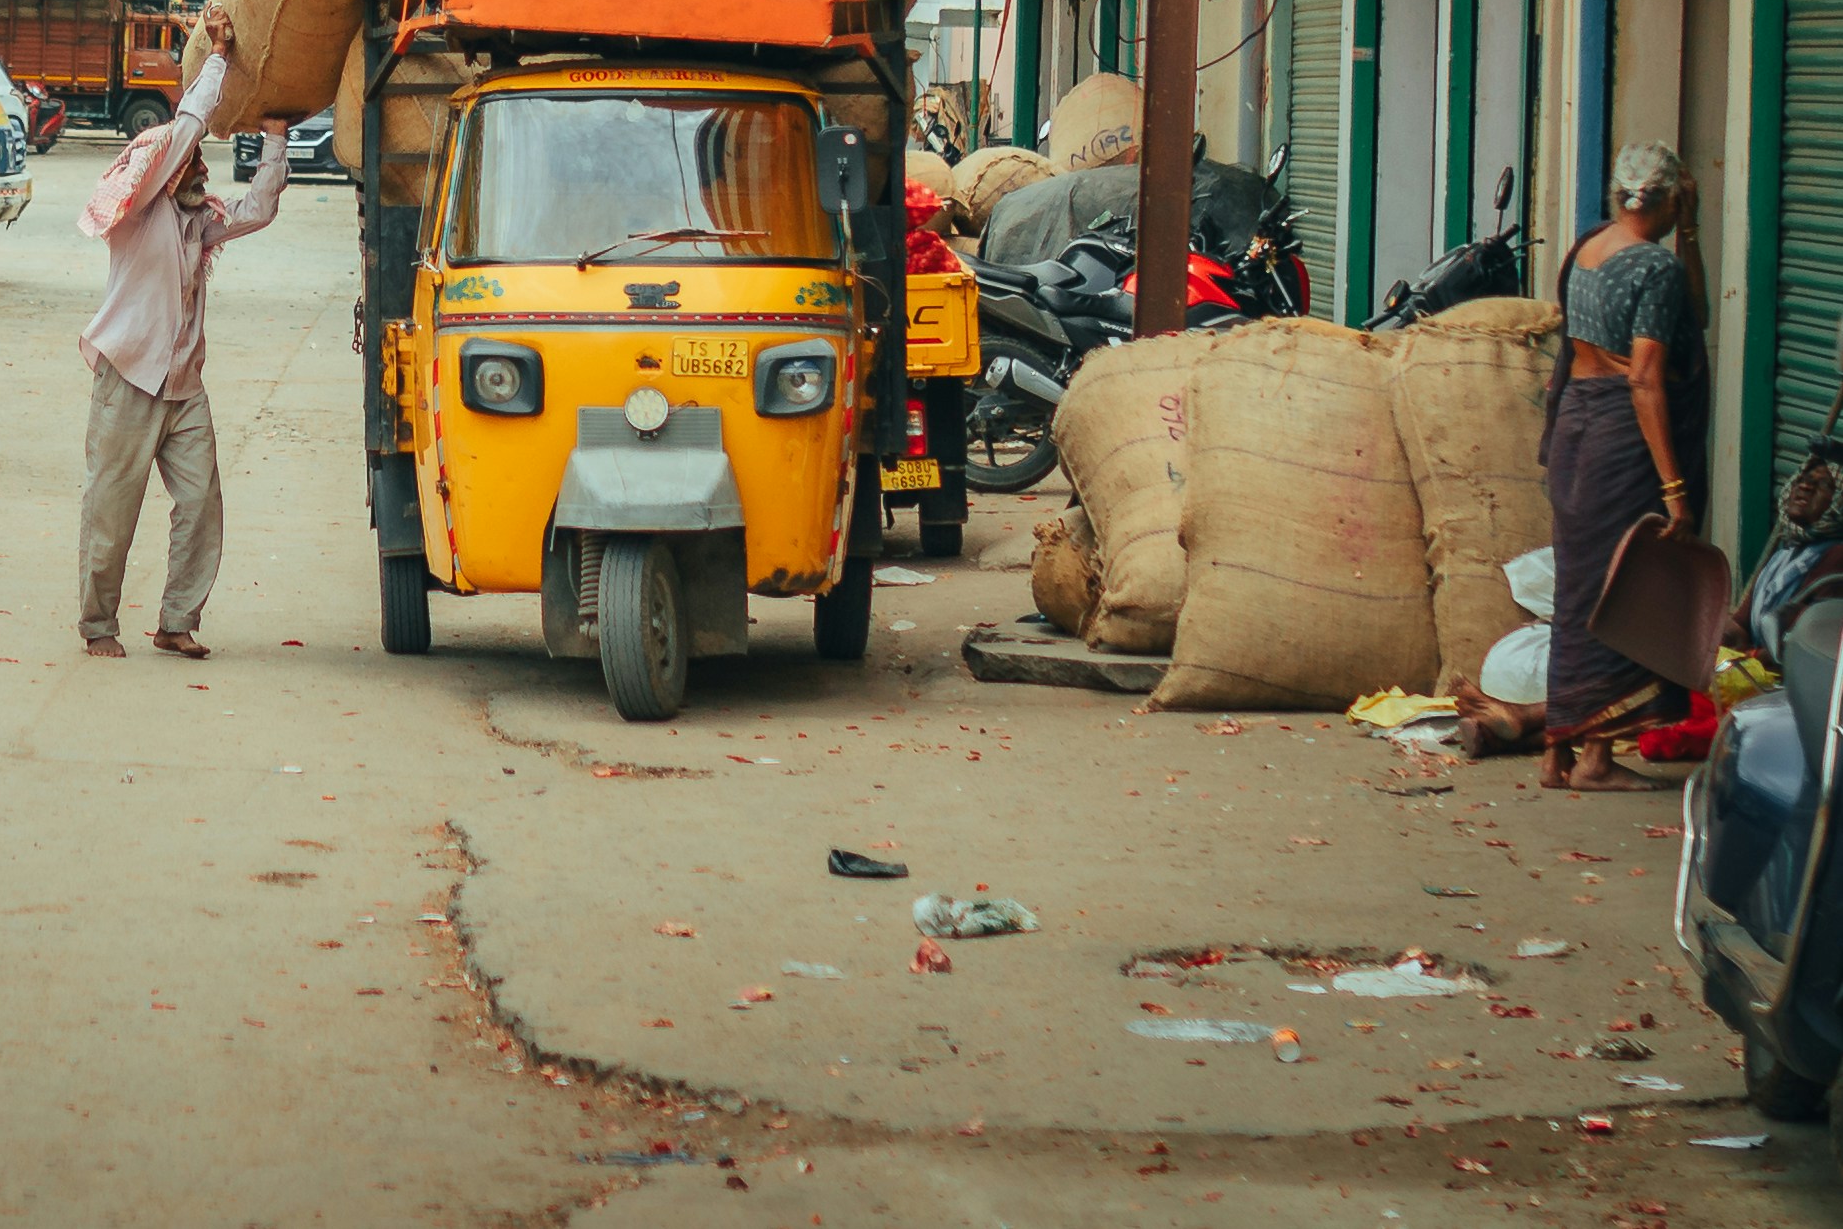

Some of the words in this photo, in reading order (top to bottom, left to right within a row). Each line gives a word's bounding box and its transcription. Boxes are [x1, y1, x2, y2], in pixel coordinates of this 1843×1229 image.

[688, 341, 708, 356] TS
[720, 342, 738, 358] 12
[680, 358, 745, 375] UB5682
[894, 462, 931, 475] S08U
